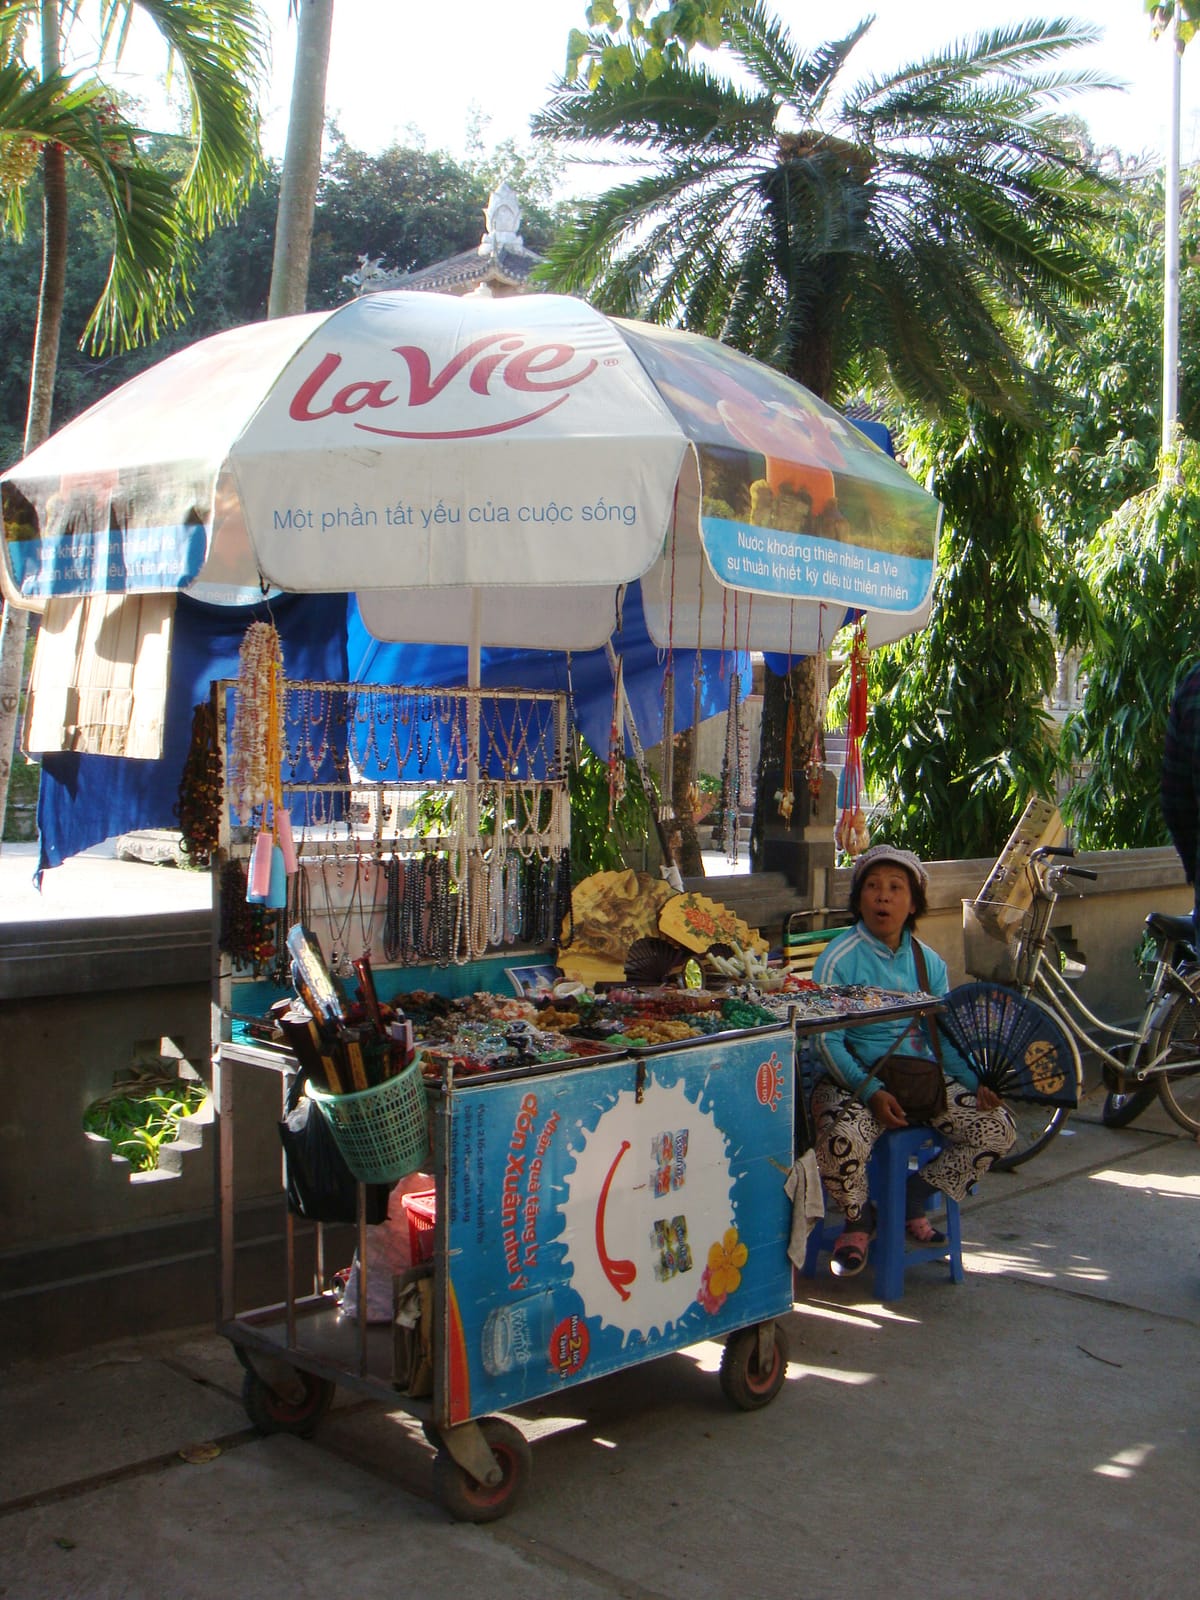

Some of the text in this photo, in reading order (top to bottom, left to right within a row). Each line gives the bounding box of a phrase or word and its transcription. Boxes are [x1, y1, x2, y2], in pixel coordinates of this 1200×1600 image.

[273, 497, 637, 532] Một phần tất yếu của cuộc sống
[766, 537, 811, 562] khoáng
[813, 545, 839, 565] thiên
[839, 552, 864, 571] nhiên
[866, 557, 881, 574] La
[882, 560, 898, 577] Vie
[854, 577, 878, 596] thiên
[880, 584, 909, 601] nhiên
[509, 1093, 540, 1150] đón
[536, 1110, 562, 1156] Nhận
[501, 1154, 527, 1228] Xuân
[527, 1158, 544, 1193] quà
[520, 1196, 540, 1243] tặng
[502, 1230, 524, 1275] như
[569, 1314, 582, 1366] Mua 2 lốc
[559, 1357, 572, 1368] 1
[559, 1368, 568, 1380] ly
